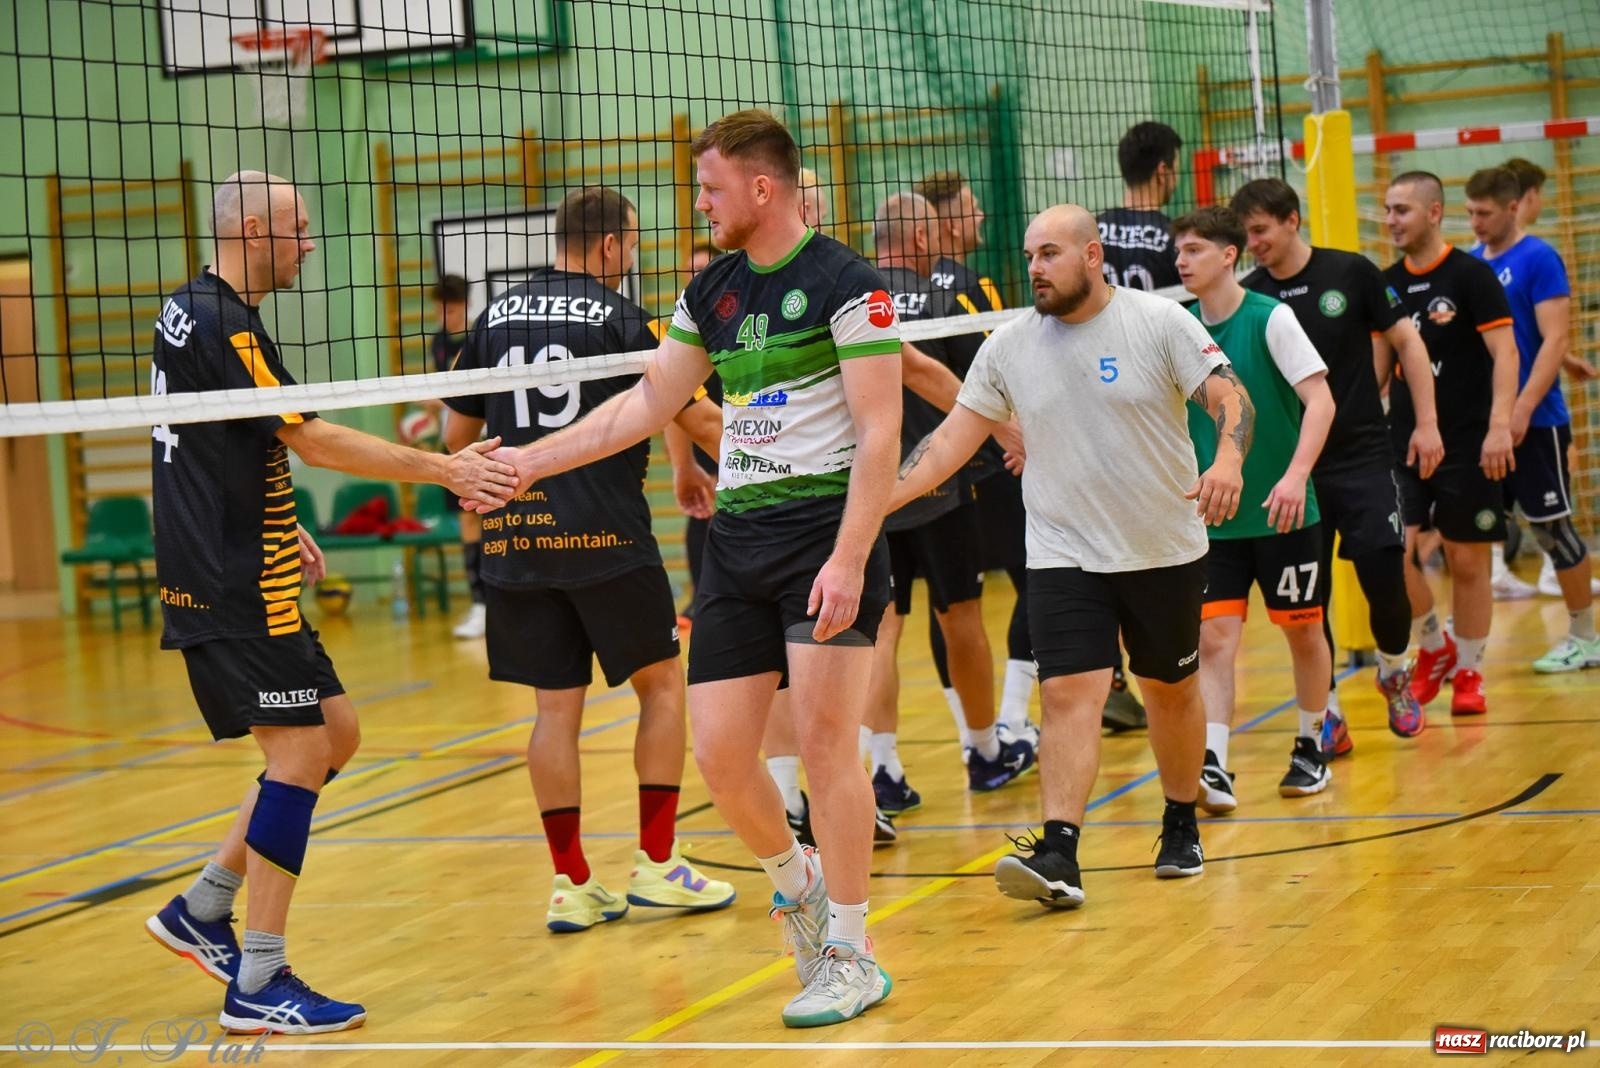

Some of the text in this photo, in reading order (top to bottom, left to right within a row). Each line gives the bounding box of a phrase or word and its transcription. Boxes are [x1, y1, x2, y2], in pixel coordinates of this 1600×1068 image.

[1098, 222, 1170, 252] OLTECH
[488, 295, 613, 327] KOLTECH
[736, 314, 769, 351] 49
[496, 343, 581, 428] 19
[1100, 357, 1119, 383] 5
[483, 513, 556, 531] easy to use,
[484, 539, 507, 556] easy
[512, 535, 530, 550] to
[1276, 561, 1320, 603] 47
